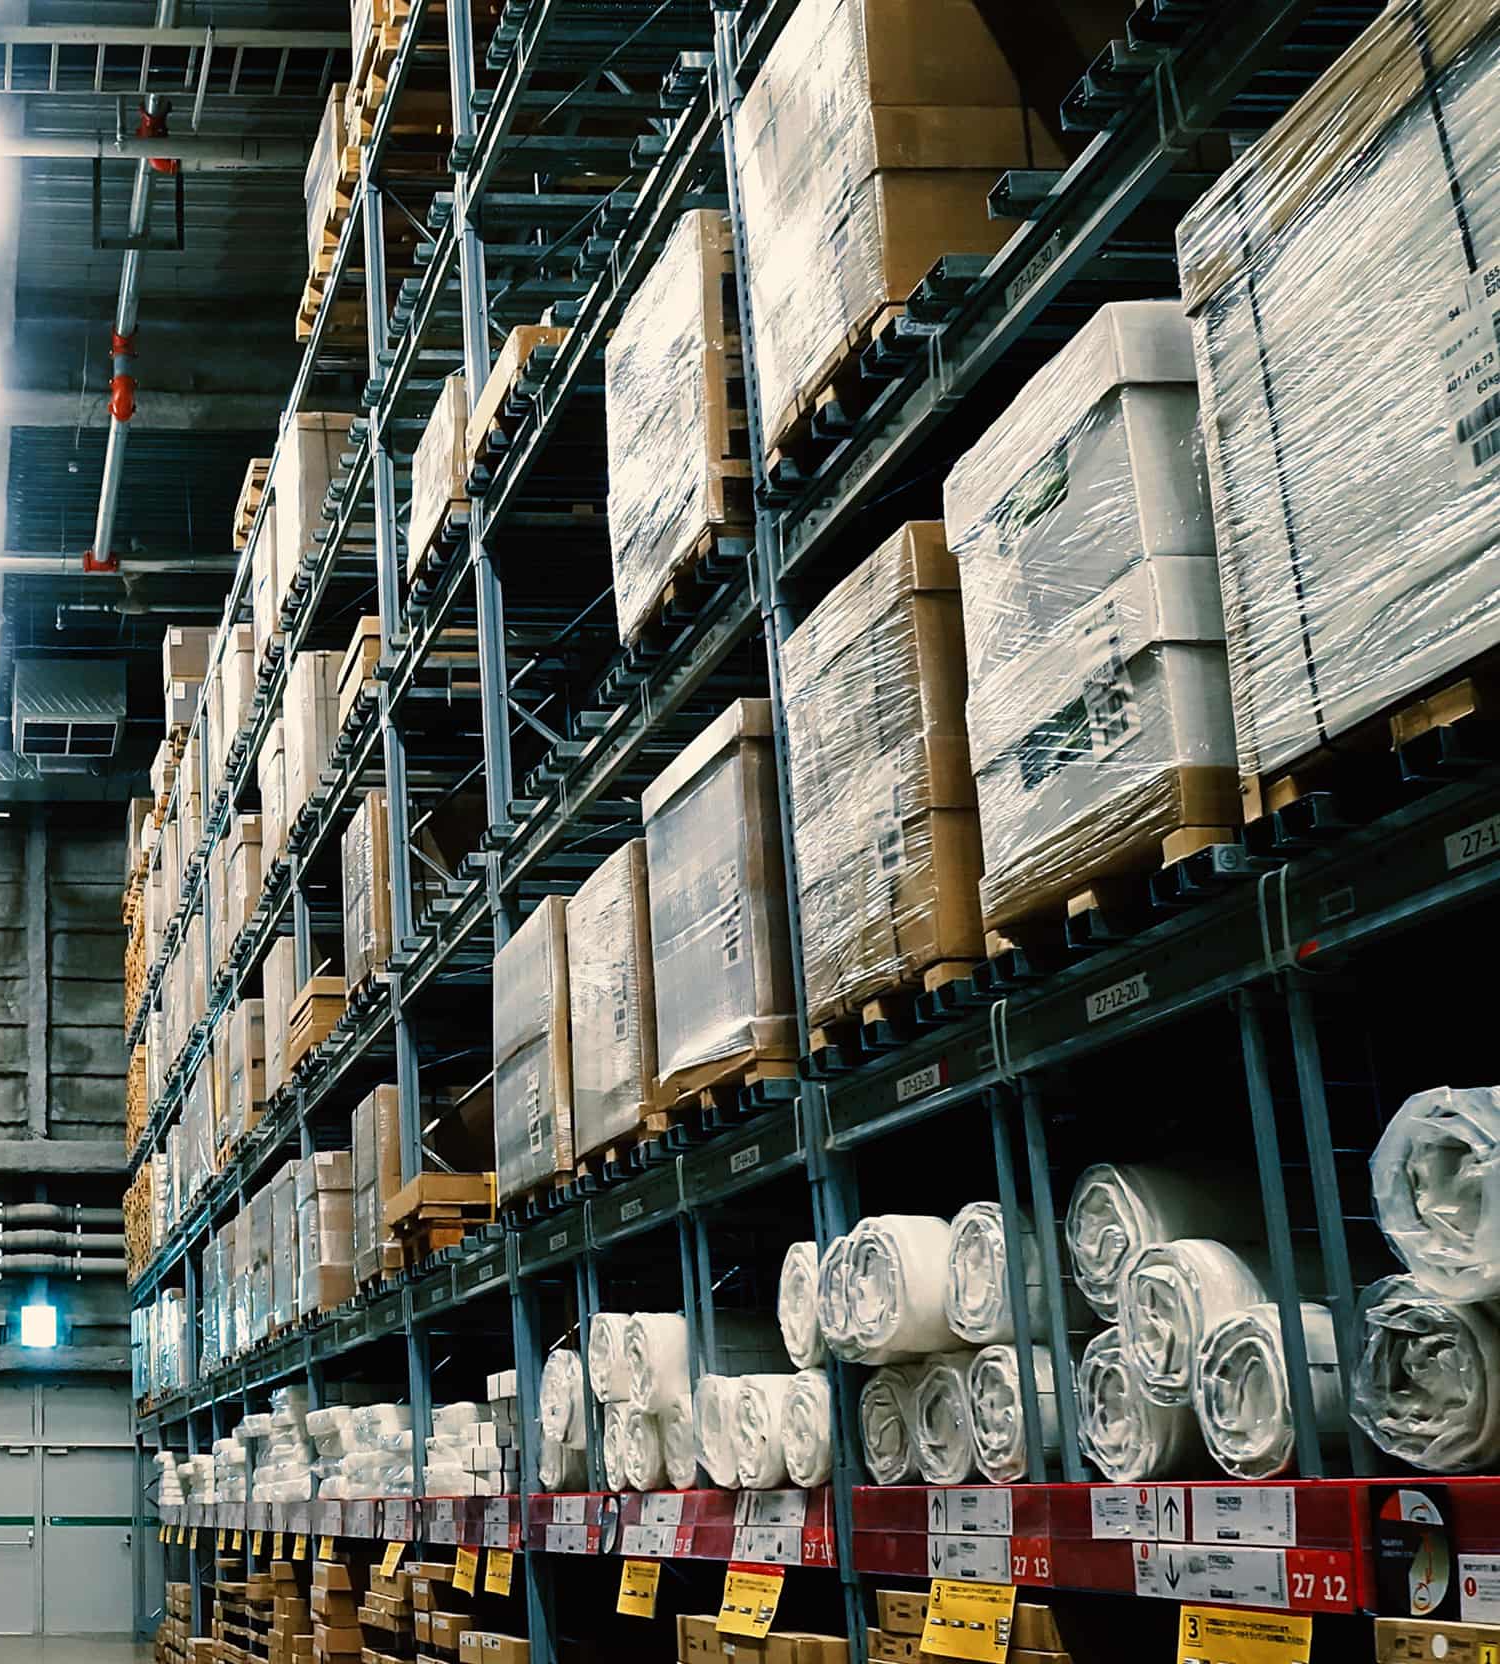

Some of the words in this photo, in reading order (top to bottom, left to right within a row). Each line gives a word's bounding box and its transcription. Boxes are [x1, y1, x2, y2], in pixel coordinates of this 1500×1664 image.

[1461, 823, 1500, 858] 27-1
[1095, 981, 1140, 1014] 27-12-20
[805, 1543, 816, 1559] 27
[1013, 1556, 1027, 1577] 27
[1034, 1557, 1049, 1578] 13
[934, 1586, 942, 1603] 3
[1292, 1573, 1315, 1599] 27
[1323, 1575, 1348, 1601] 12
[1188, 1617, 1199, 1639] 3
